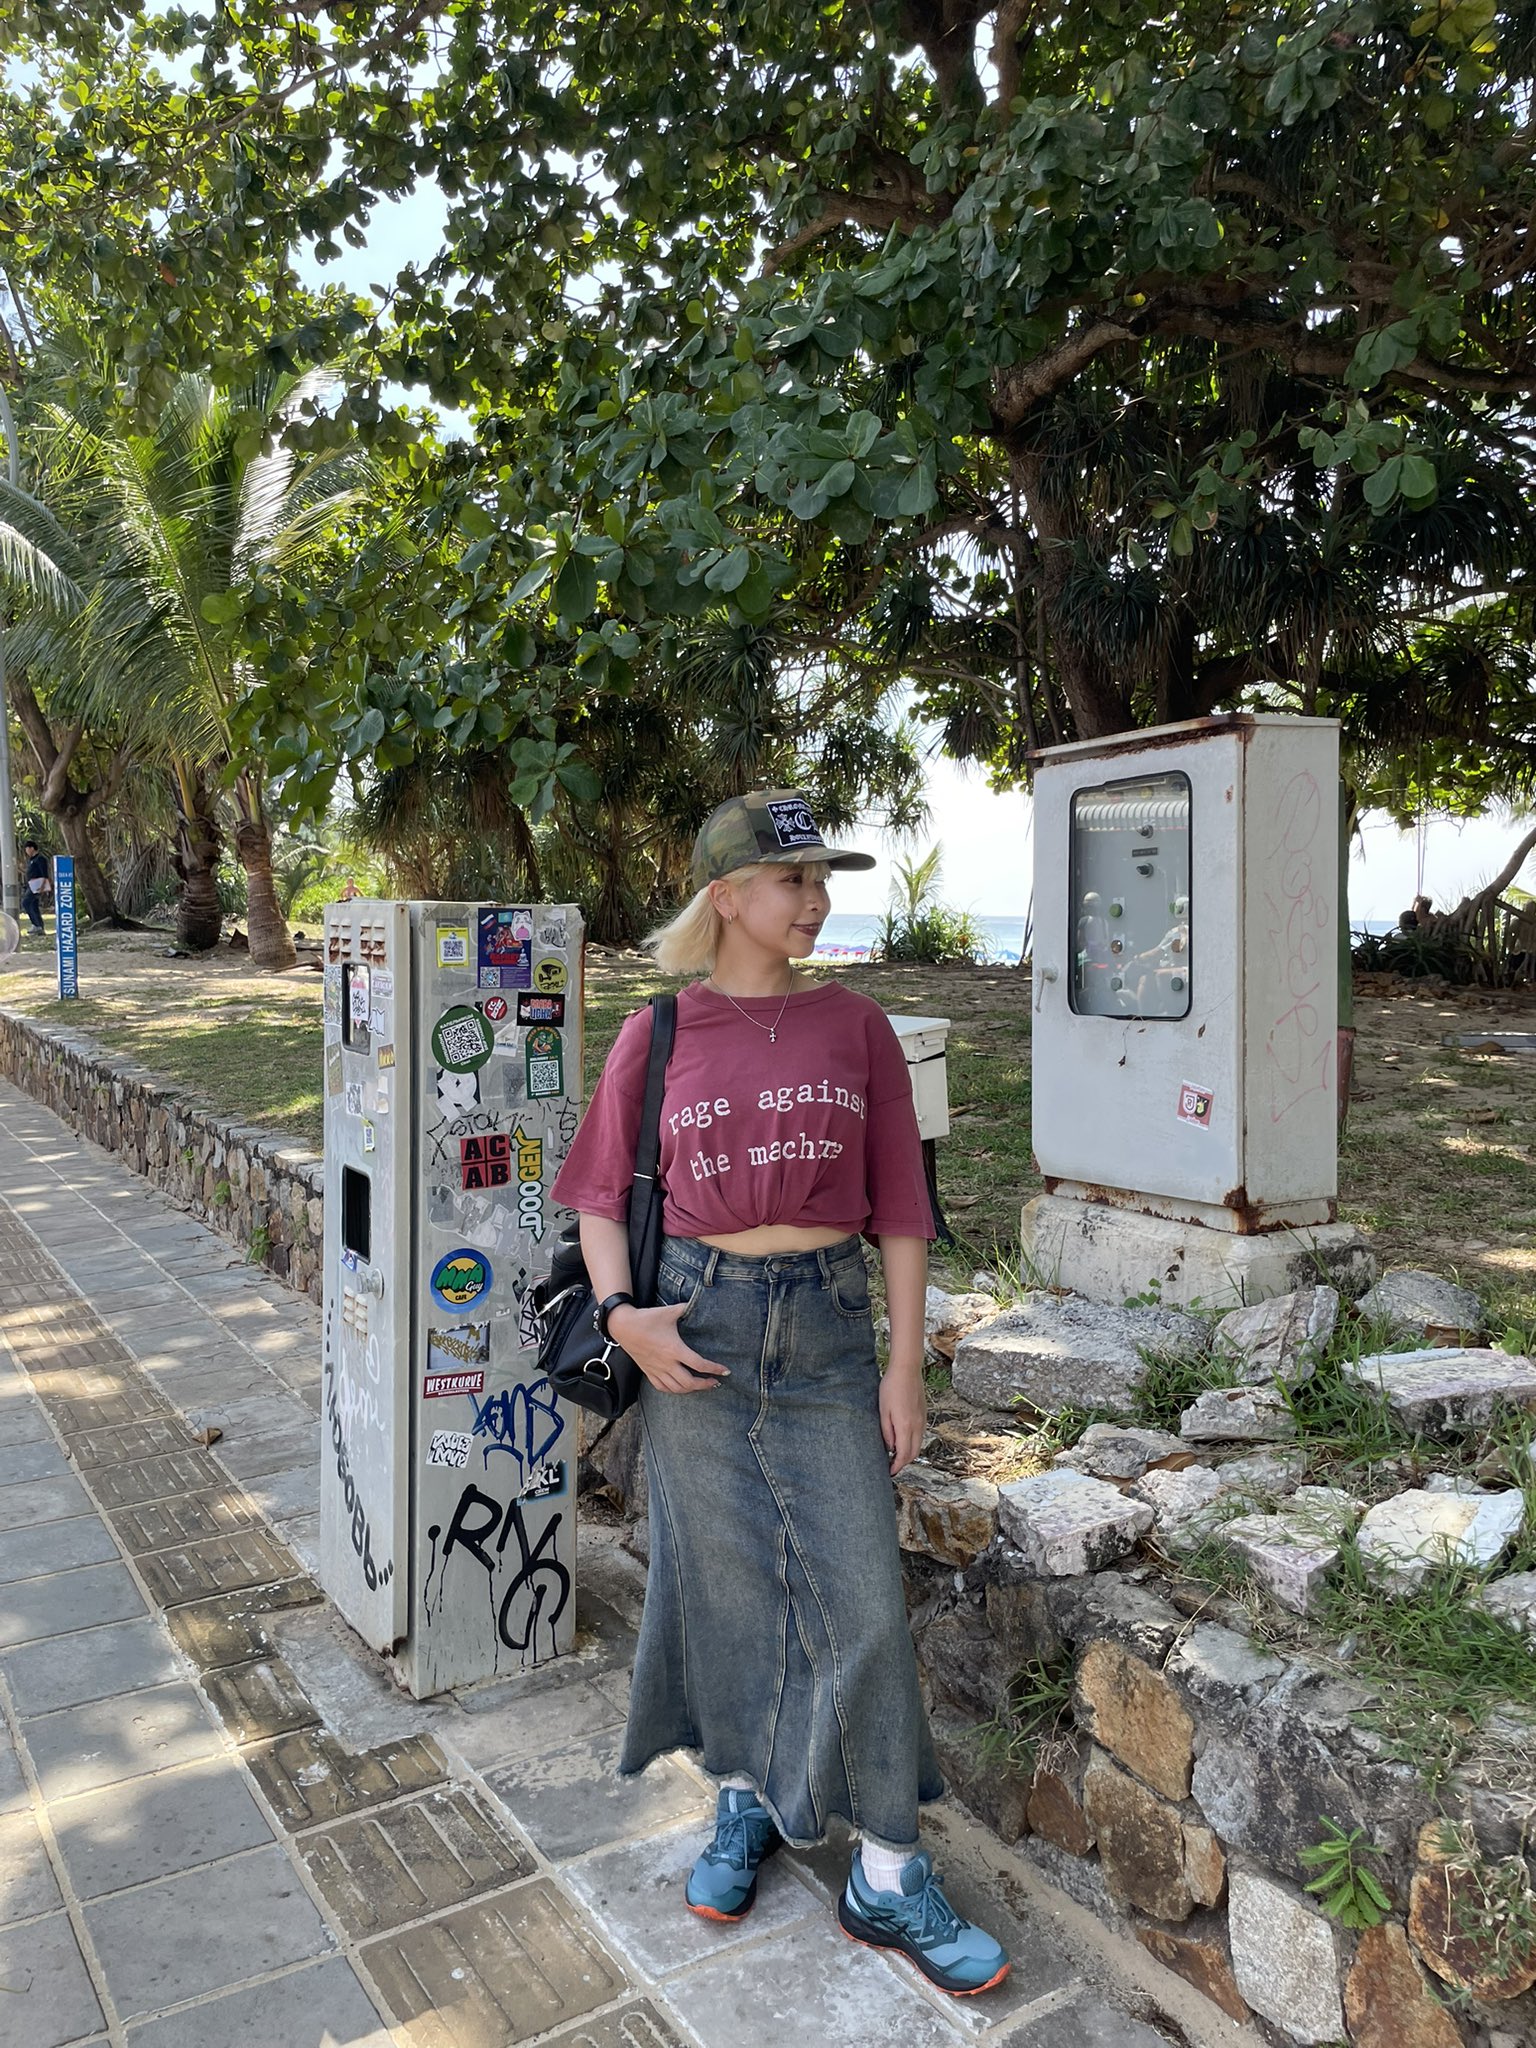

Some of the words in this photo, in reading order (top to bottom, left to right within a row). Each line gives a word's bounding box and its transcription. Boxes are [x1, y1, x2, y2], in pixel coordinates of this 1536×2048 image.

[60, 881, 73, 909] ZONE
[61, 912, 74, 952] HAZARD
[668, 1097, 731, 1135] rage
[690, 1151, 731, 1181] the
[465, 1281, 484, 1292] Guy
[427, 1373, 482, 1392] WESTKURVE
